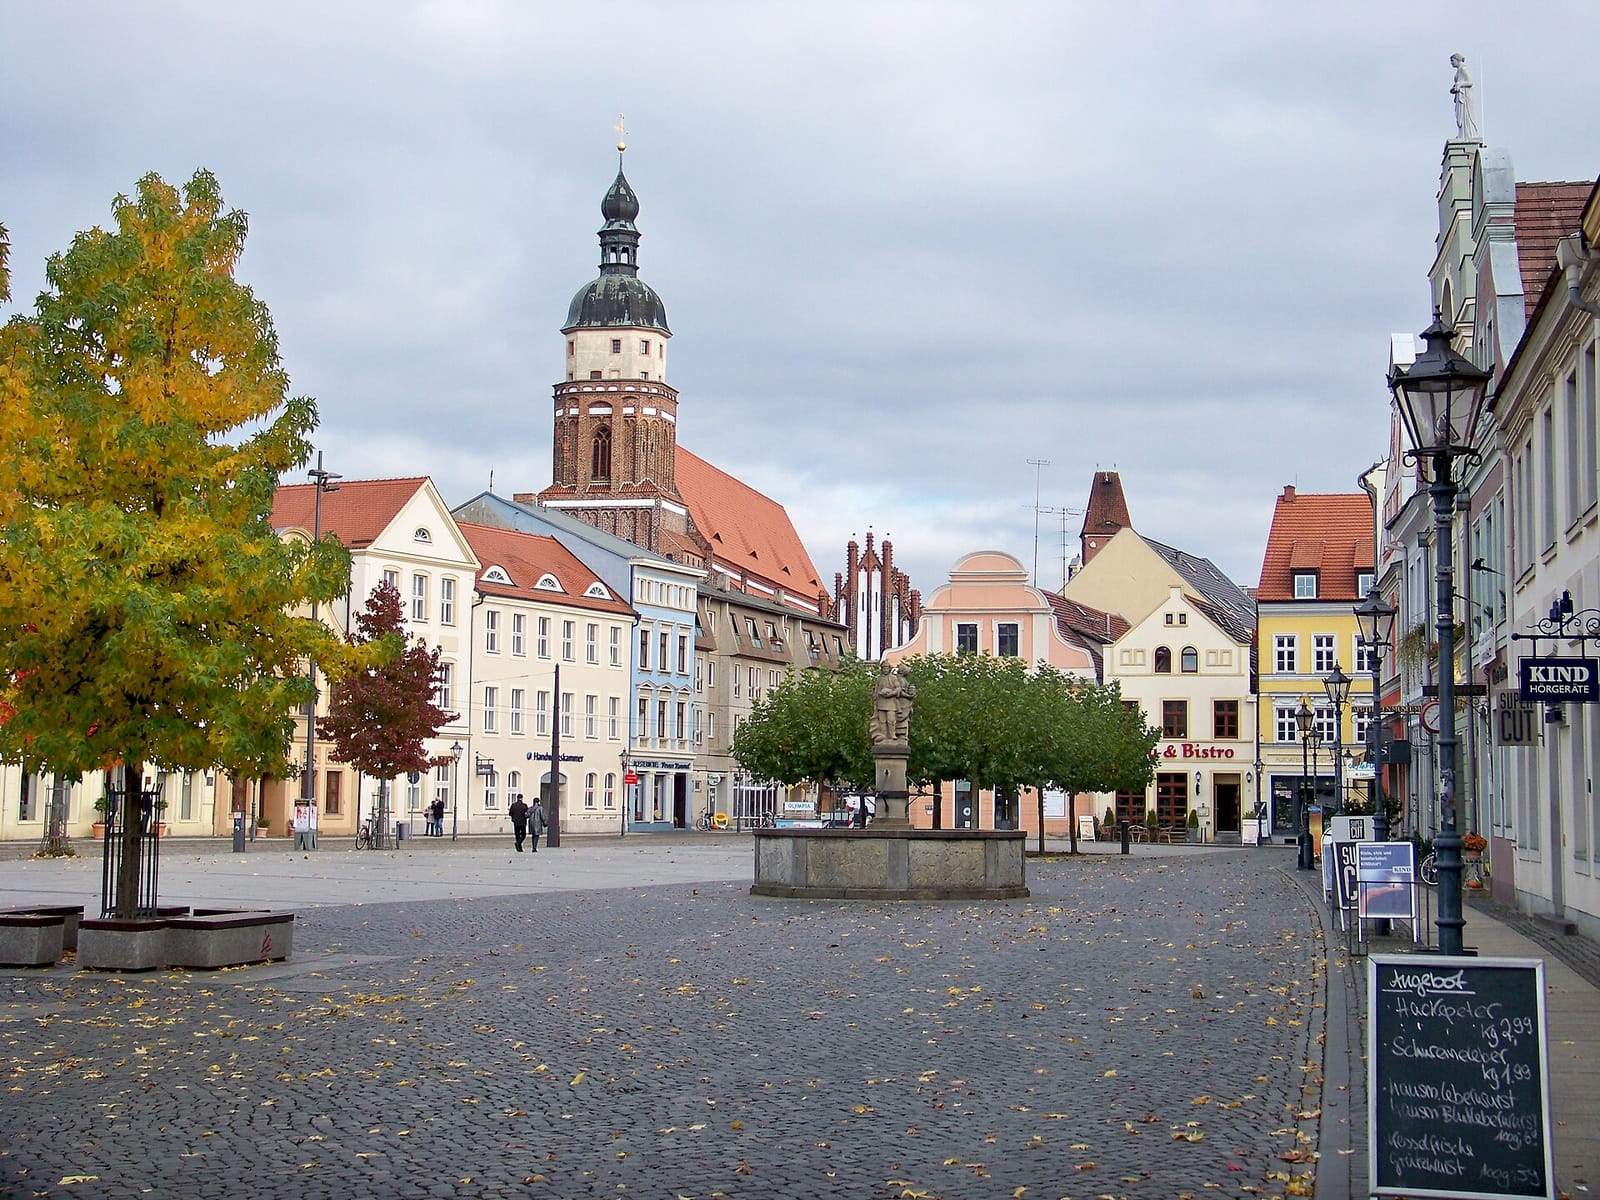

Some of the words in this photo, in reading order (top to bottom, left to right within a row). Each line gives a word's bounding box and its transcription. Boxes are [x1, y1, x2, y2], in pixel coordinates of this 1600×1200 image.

[1529, 666, 1590, 682] KIND
[1529, 682, 1590, 694] HÖRGERÄTE
[1501, 710, 1534, 742] CUT
[1163, 745, 1177, 758] &
[1181, 743, 1235, 759] Bistro
[1390, 969, 1467, 996] Angebot
